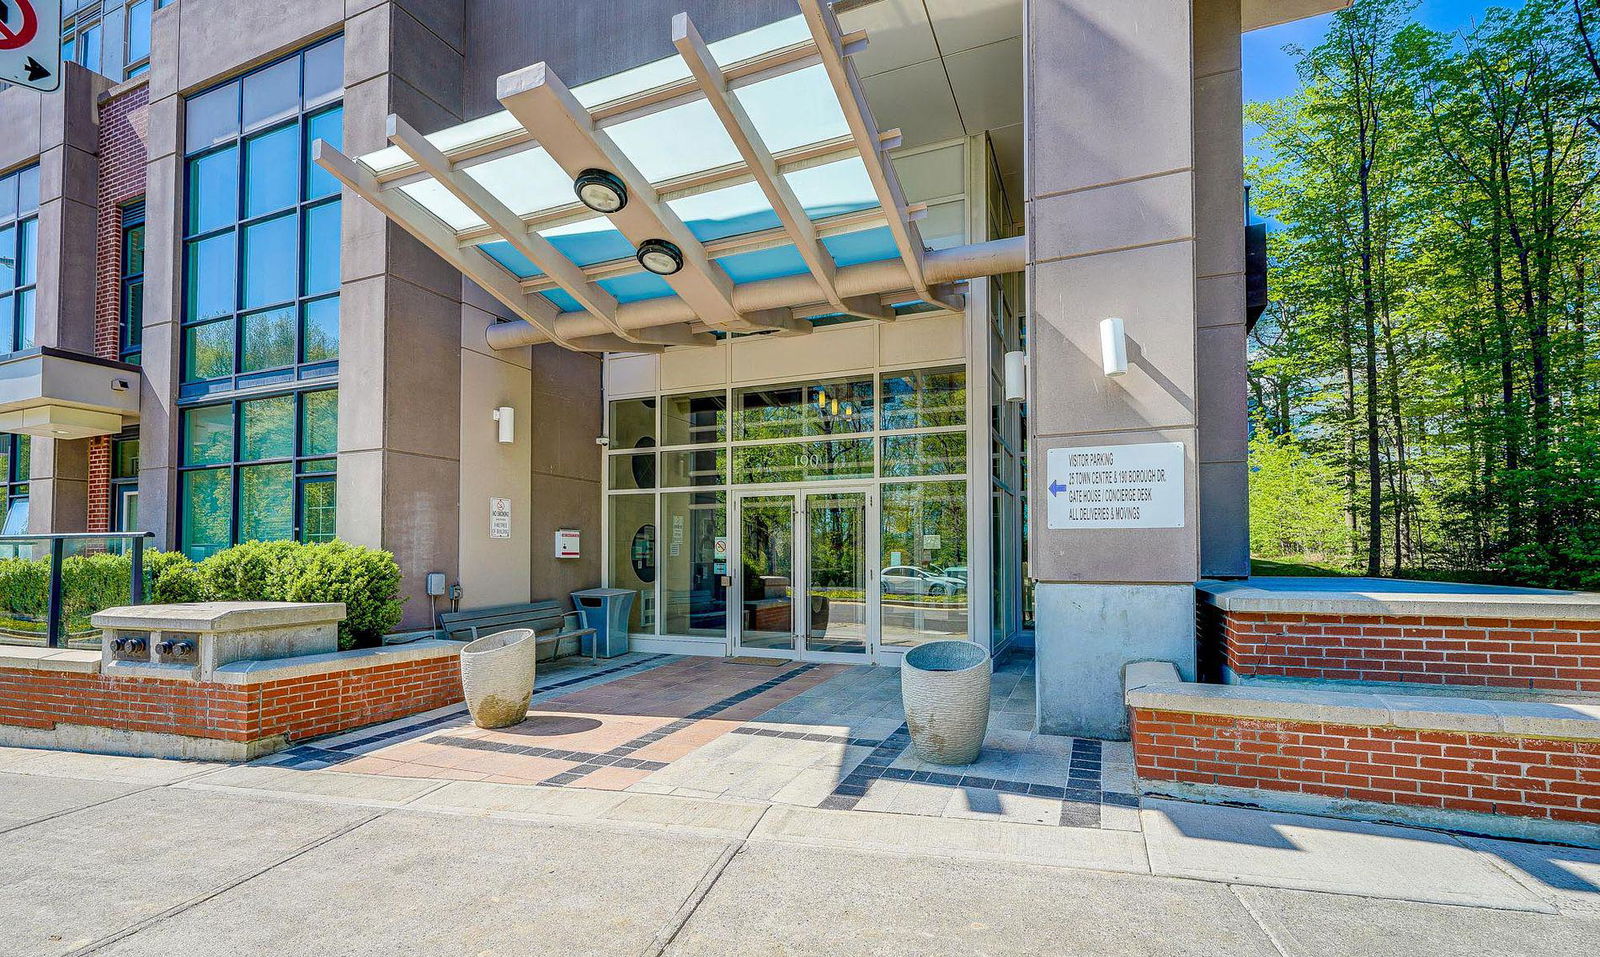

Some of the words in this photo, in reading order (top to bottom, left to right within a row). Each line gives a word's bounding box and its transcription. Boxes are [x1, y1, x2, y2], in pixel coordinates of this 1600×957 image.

[794, 454, 819, 469] 190
[1068, 453, 1089, 467] VISITOR
[1089, 452, 1114, 466] PARKING
[1068, 472, 1075, 485] 25
[1075, 472, 1091, 485] TOWN
[1091, 471, 1112, 484] CENTRE
[1113, 471, 1118, 483] &
[1128, 469, 1156, 483] BOROUGH
[1156, 469, 1167, 483] DR.
[1068, 489, 1083, 503] GATE
[1083, 489, 1101, 503] HOUSE
[1105, 488, 1136, 502] CONCIERGE
[1137, 488, 1152, 502] DESK
[1068, 508, 1079, 520] ALL
[1079, 507, 1109, 520] DELIVERIES
[1110, 507, 1115, 520] &
[1115, 507, 1141, 520] MOVINGS
